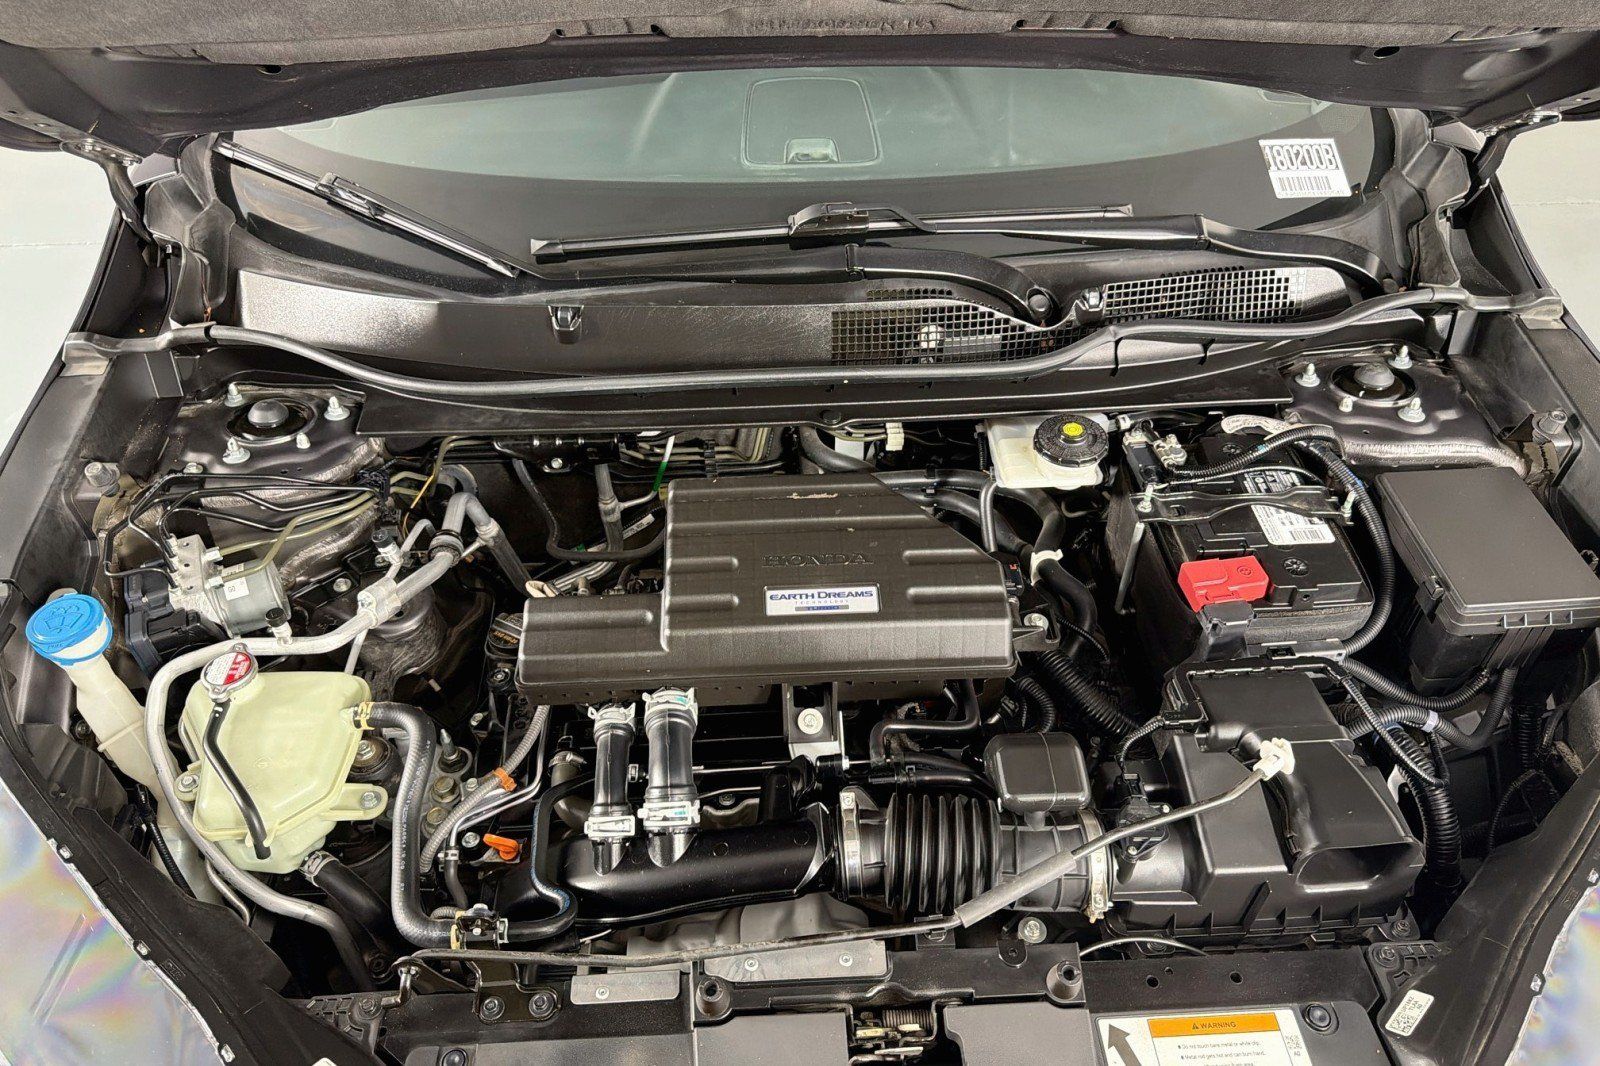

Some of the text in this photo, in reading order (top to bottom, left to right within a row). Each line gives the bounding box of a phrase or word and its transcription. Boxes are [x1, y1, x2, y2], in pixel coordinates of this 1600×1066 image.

[761, 552, 874, 567] HONDA
[769, 590, 874, 601] EARTH DREAMS
[1200, 1021, 1237, 1029] WARNING
